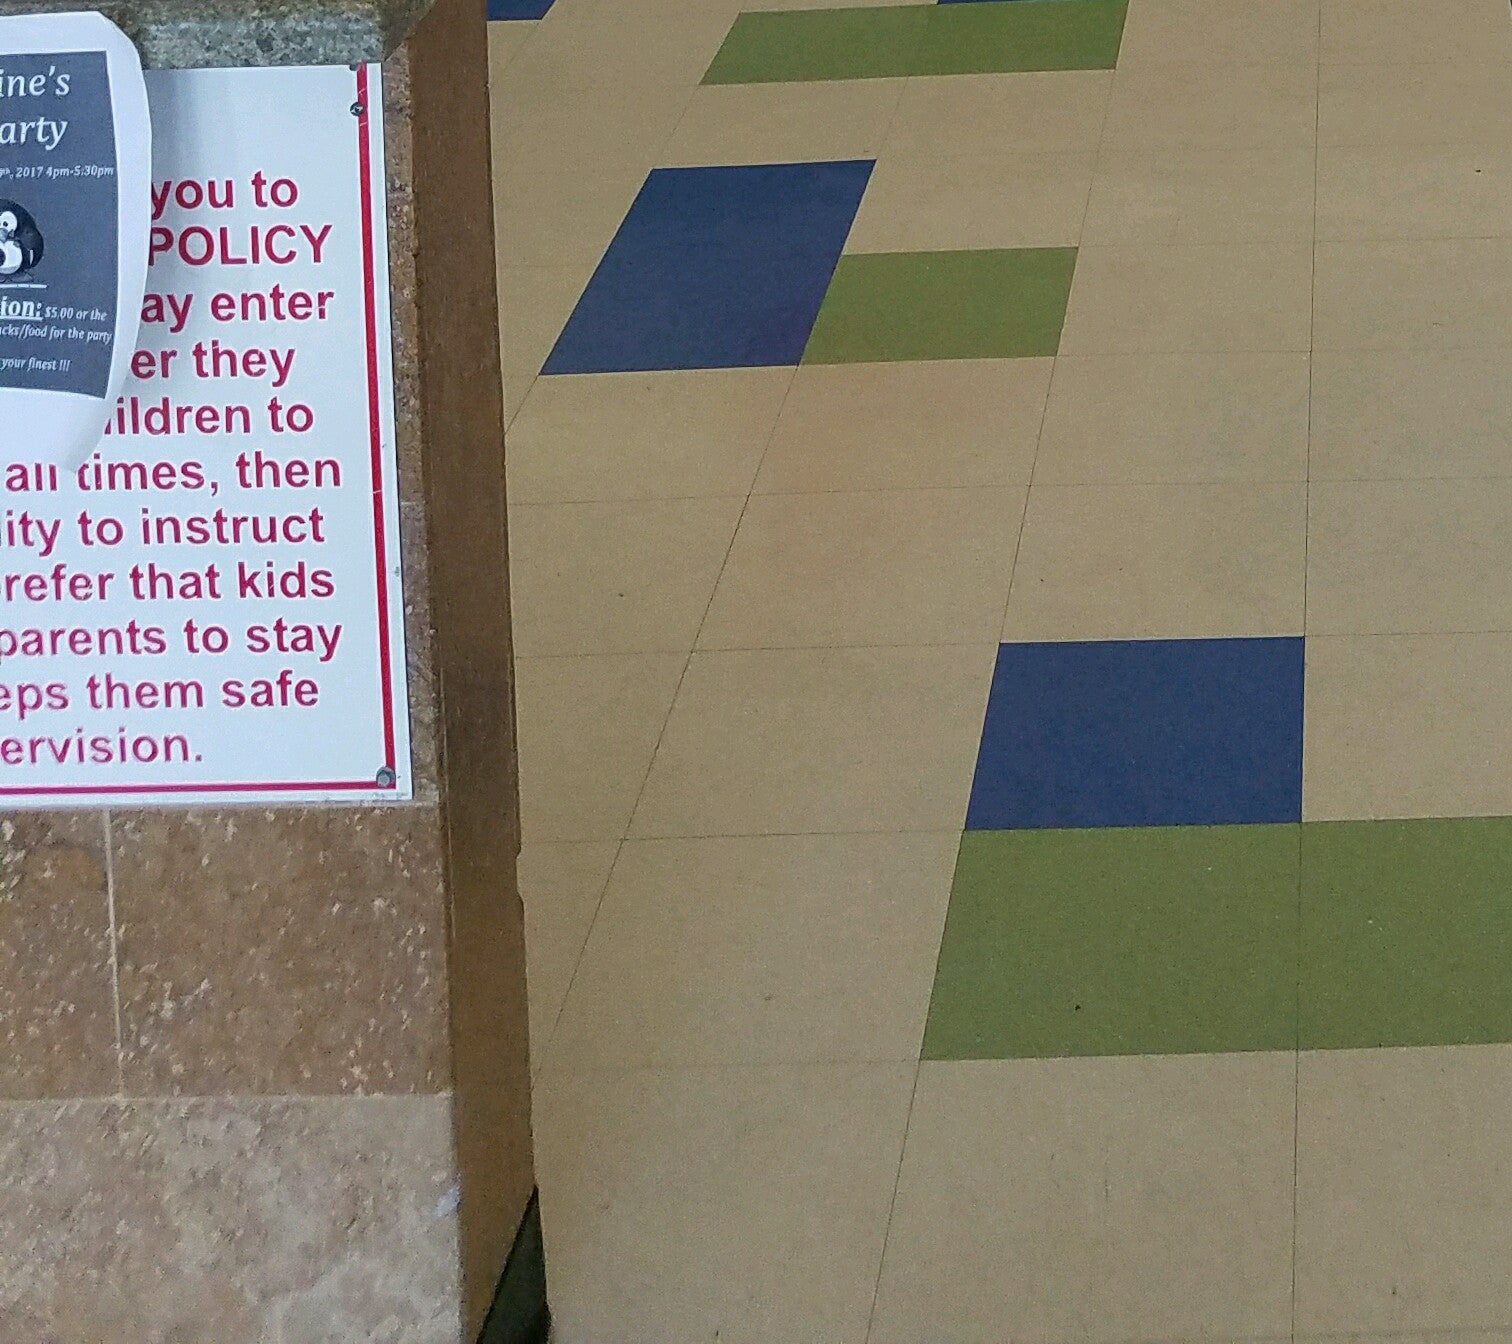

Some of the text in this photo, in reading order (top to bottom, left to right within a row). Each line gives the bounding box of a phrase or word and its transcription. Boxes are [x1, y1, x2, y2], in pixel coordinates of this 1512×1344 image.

[16, 166, 44, 178] 2017
[151, 170, 298, 220] you to
[148, 224, 333, 267] POLICY
[76, 310, 89, 321] or
[90, 308, 108, 322] the
[210, 283, 335, 321] enter
[0, 323, 113, 346] cks/food for the party
[0, 358, 26, 371] your
[130, 340, 296, 387] er they
[103, 396, 314, 436] ildren to
[235, 451, 341, 488] then
[77, 509, 124, 547] to
[141, 506, 325, 546] instruct
[5, 561, 335, 602] refer that kids
[183, 617, 229, 654] to
[246, 616, 342, 662] stay
[86, 672, 203, 710] them
[221, 669, 320, 709] safe
[1, 726, 203, 764] ervision.
